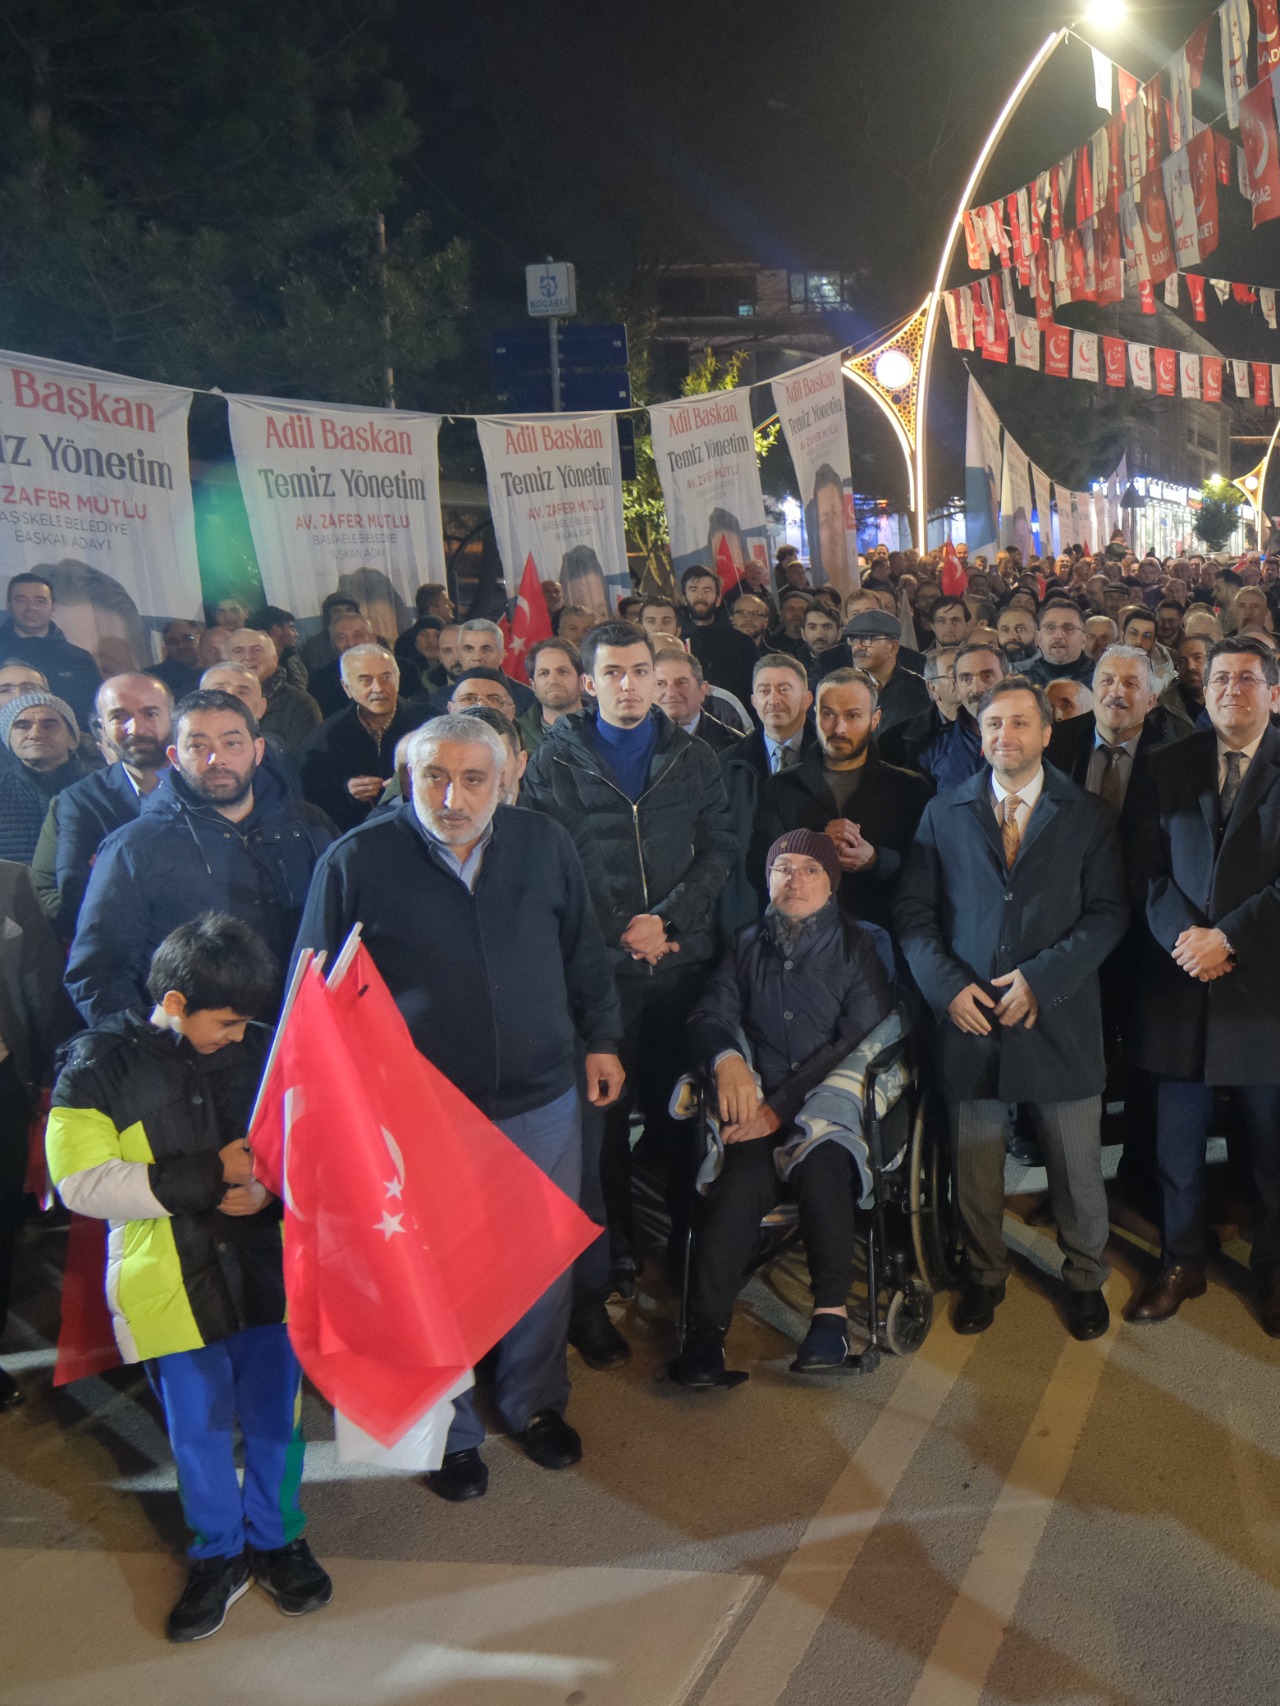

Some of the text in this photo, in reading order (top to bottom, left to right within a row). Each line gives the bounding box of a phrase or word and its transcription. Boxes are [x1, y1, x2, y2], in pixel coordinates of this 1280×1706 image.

[11, 368, 156, 433] Başkan
[266, 414, 413, 455] Adil Başkan
[669, 402, 738, 437] Adil Başkan
[505, 422, 603, 455] Adil Başkan
[666, 432, 750, 473] Temiz Yönetim
[39, 433, 174, 491] Yönetim
[257, 465, 427, 501] Temiz Yönetim
[500, 465, 555, 497] Temiz
[1, 484, 147, 520] ZAFER MUTLU
[319, 513, 363, 529] ZAFER
